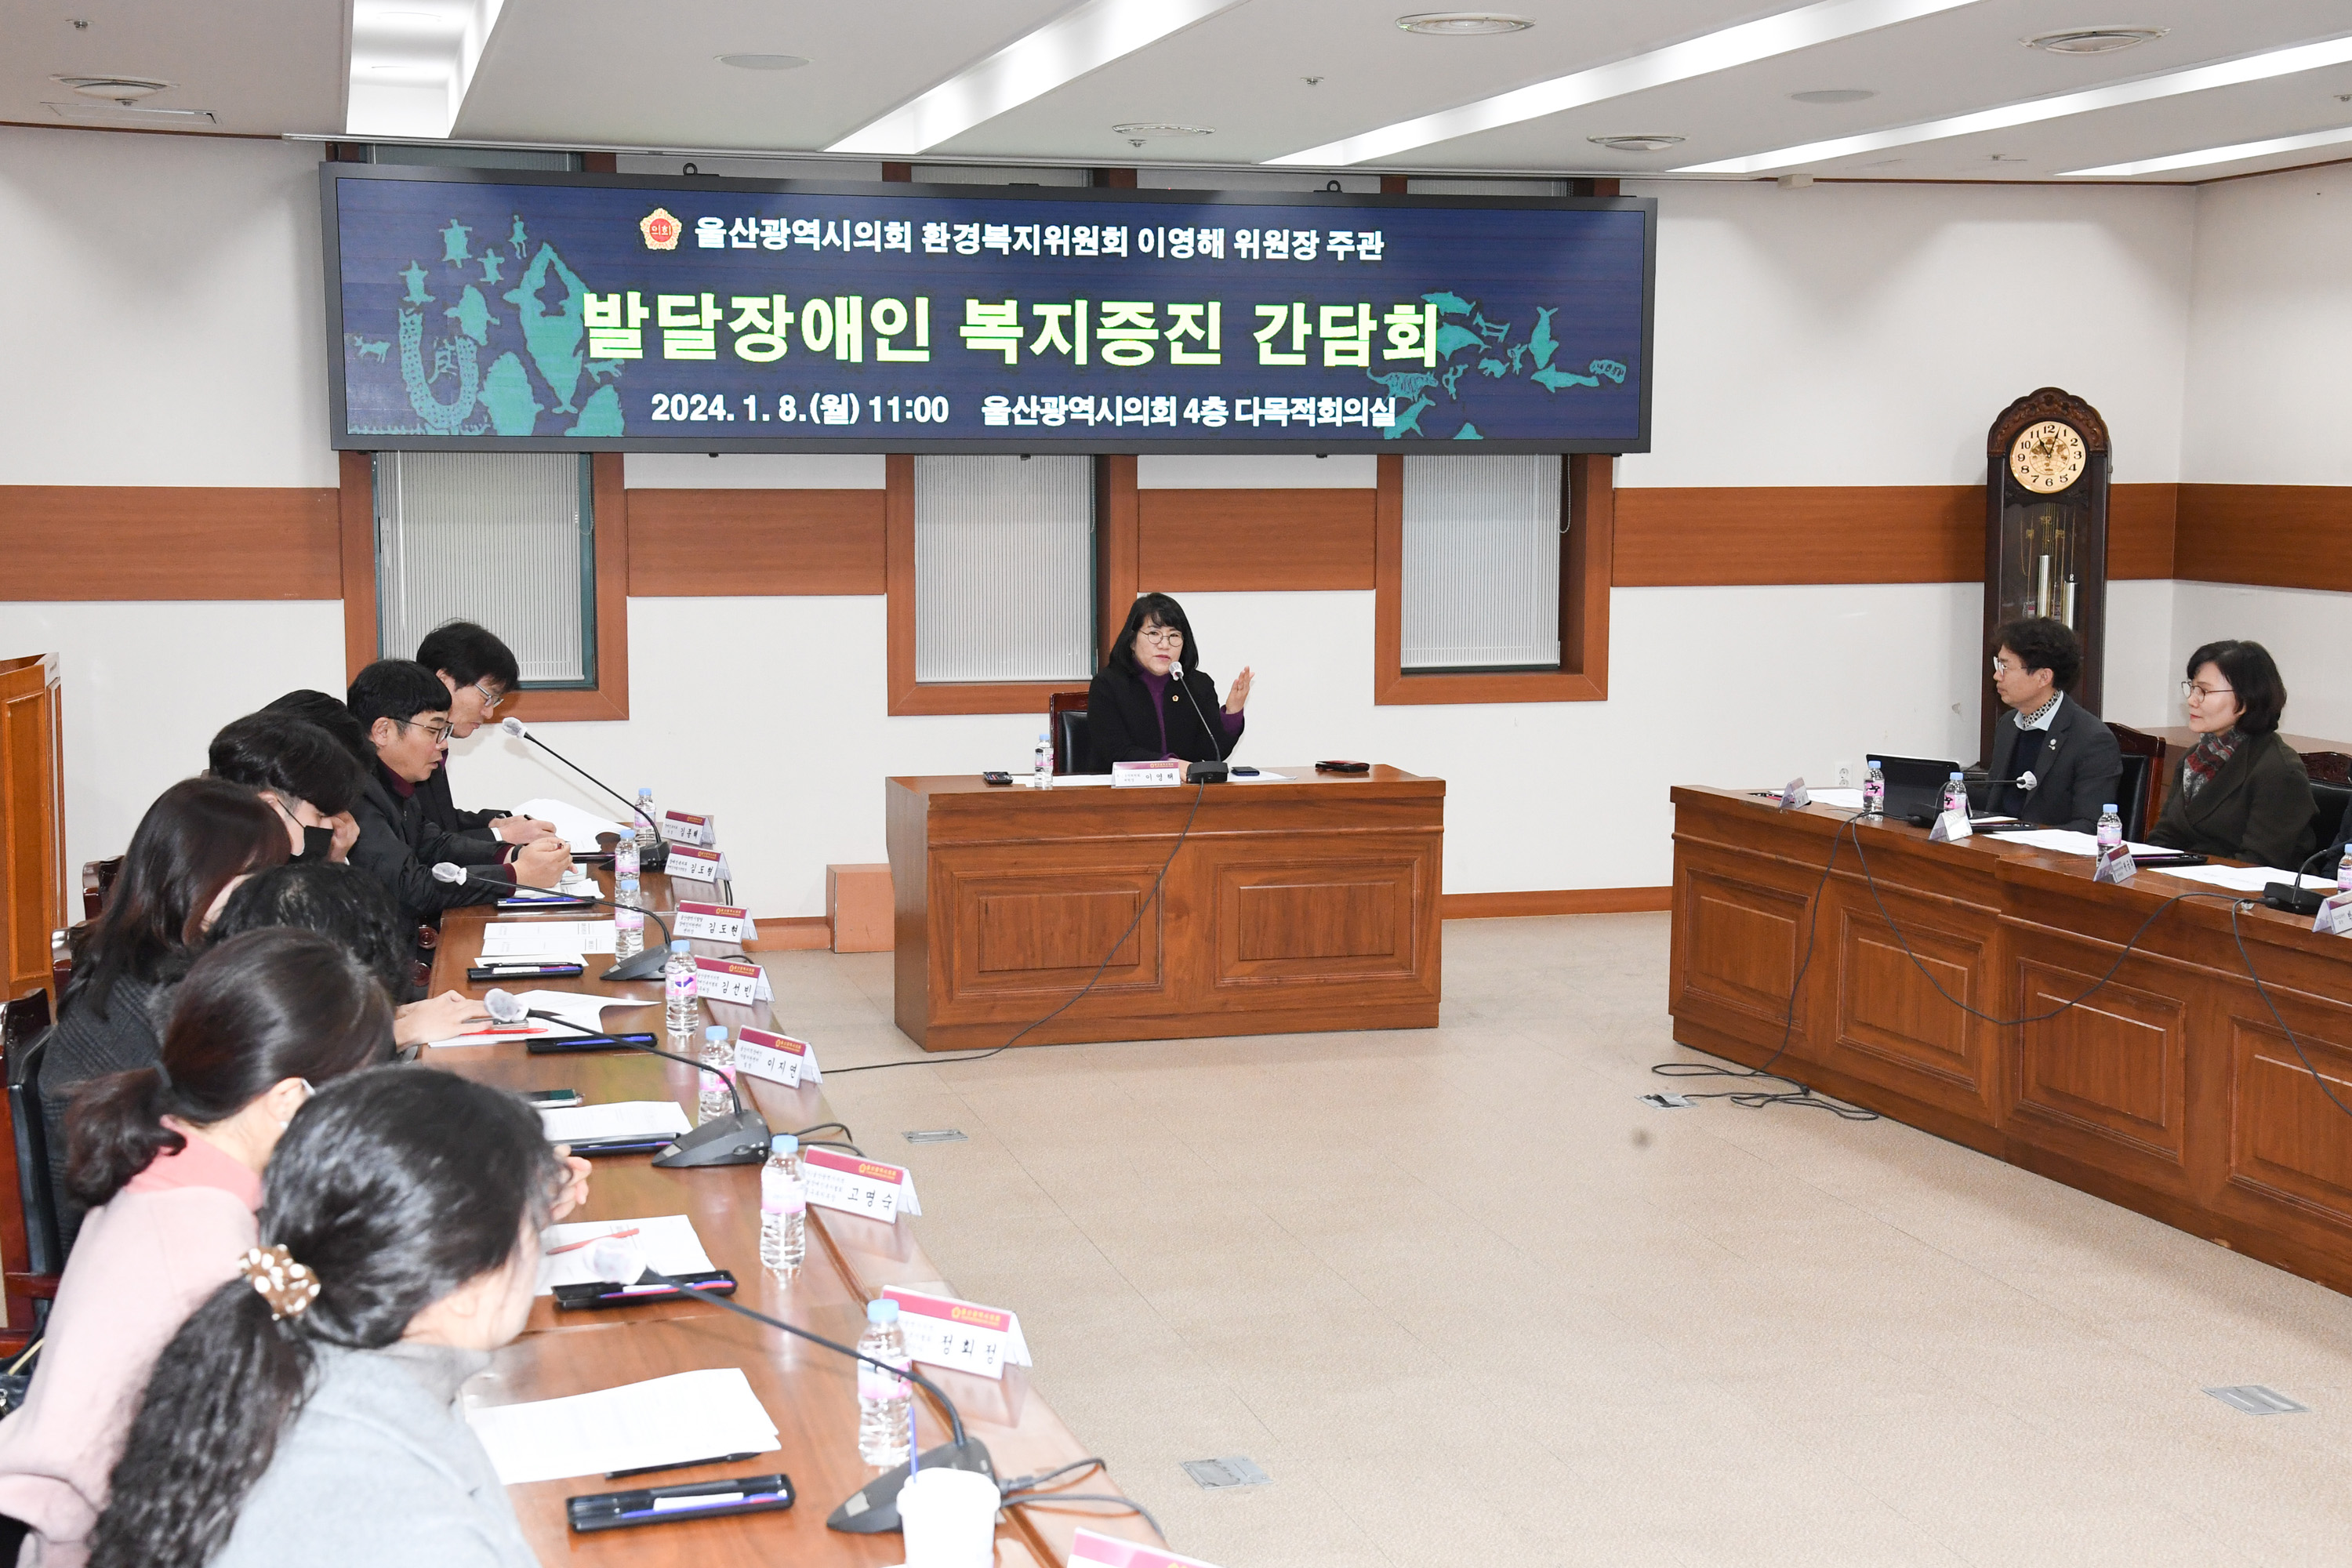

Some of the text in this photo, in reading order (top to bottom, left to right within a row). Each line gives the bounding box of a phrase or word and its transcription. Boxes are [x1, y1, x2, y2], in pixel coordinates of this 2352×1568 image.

[695, 216, 1385, 261] 울산광역시의회 환경복지위원회 이영해 위원장 주관
[583, 290, 1438, 368] 발달장애인 복지증진 간담회
[652, 392, 1396, 427] 2024. 1. 8.(월) 11:00 울산광역시의회 4층 다목적회의실
[2030, 430, 2039, 438] 11
[2043, 424, 2056, 434] 12
[2020, 440, 2031, 449] 10
[2070, 437, 2078, 446] 2
[2017, 453, 2025, 462] 9
[2073, 451, 2082, 459] 3
[2020, 465, 2030, 474] 8
[2031, 474, 2039, 483] 7
[2045, 477, 2053, 487] 6
[2060, 474, 2068, 483] 5
[708, 922, 739, 937] 김도현
[721, 980, 753, 998] 김선빈
[767, 1057, 798, 1079] 이지연
[847, 1186, 893, 1211] 고명숙
